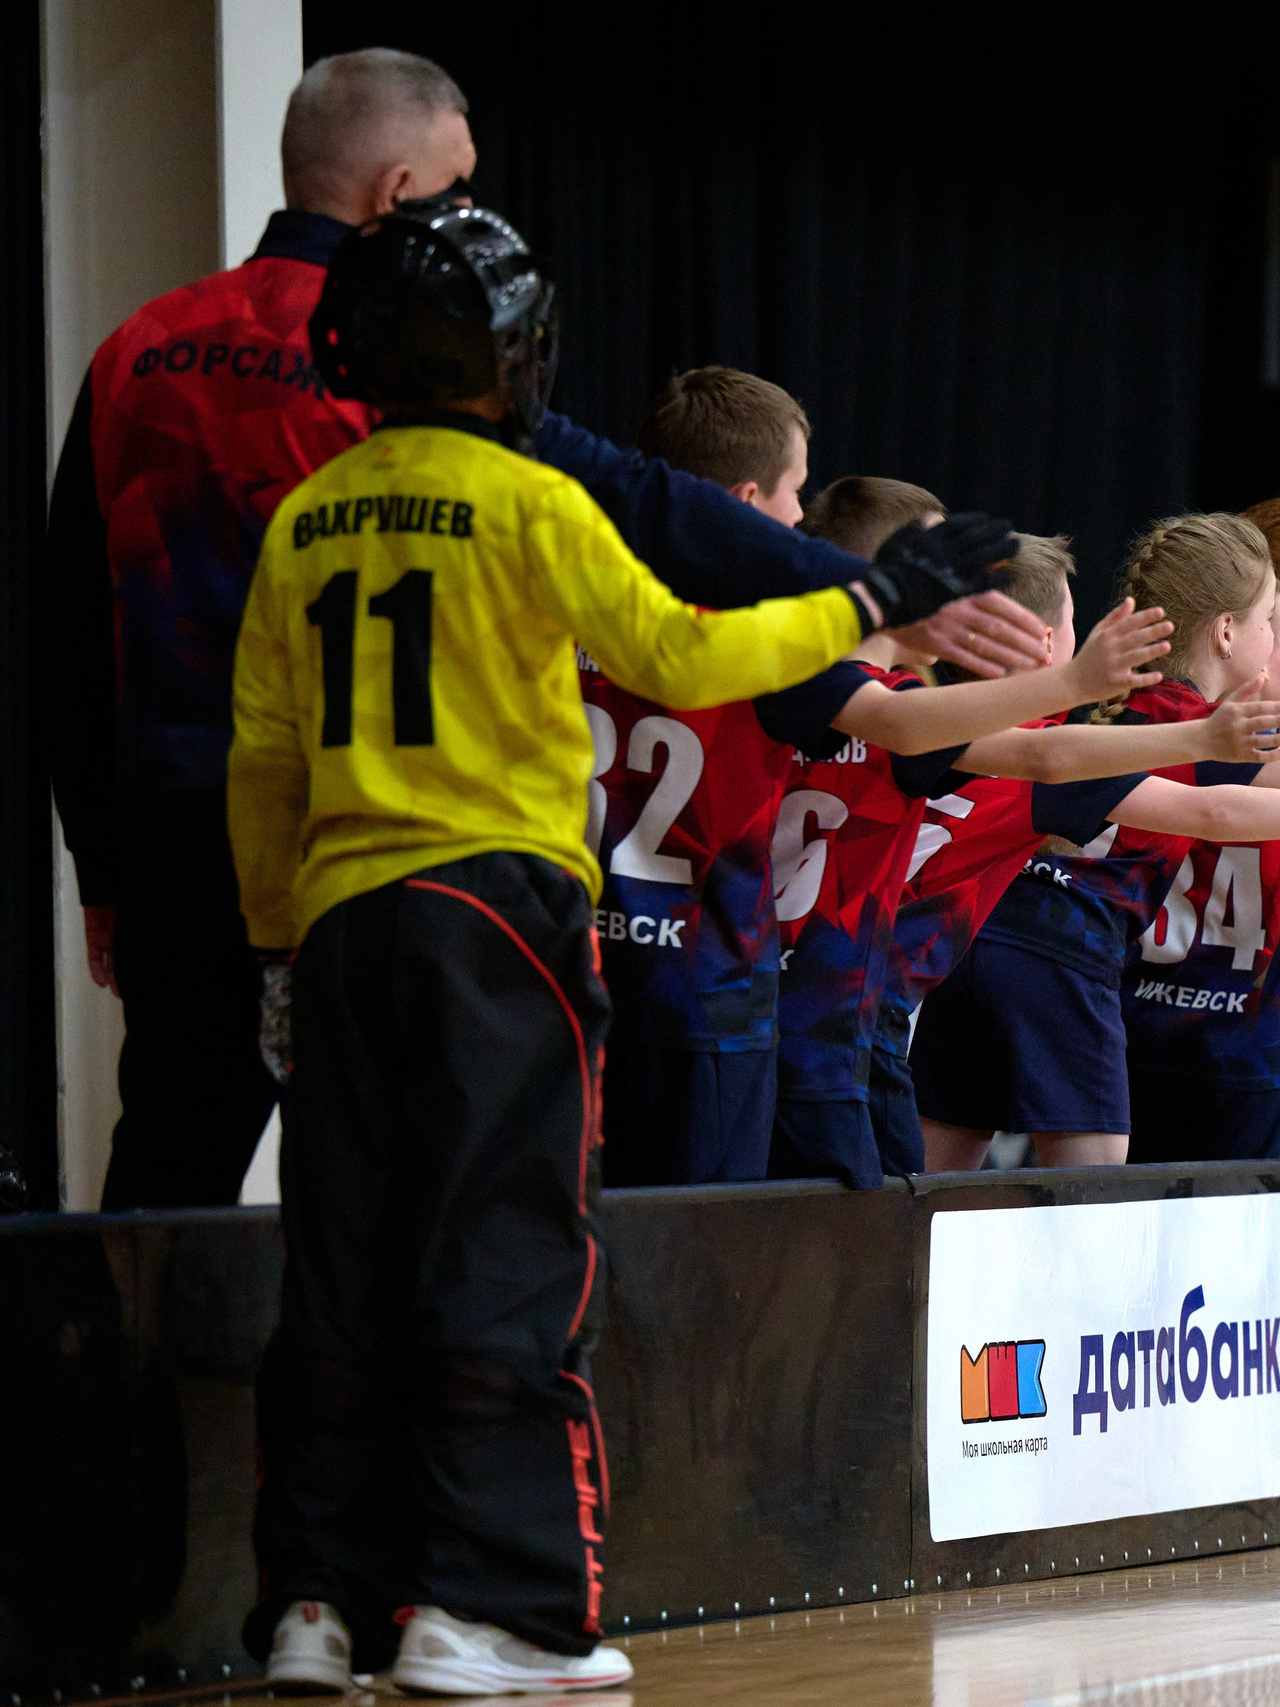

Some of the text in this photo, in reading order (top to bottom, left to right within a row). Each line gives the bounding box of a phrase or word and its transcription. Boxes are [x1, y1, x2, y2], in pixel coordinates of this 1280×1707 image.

[293, 495, 473, 551] ВАХРУШЕВ
[306, 568, 435, 750] 11
[592, 908, 686, 949] ЕВСК
[1134, 978, 1249, 1014] ИЖЕВСК
[962, 1437, 1048, 1458] Моя школьная карта
